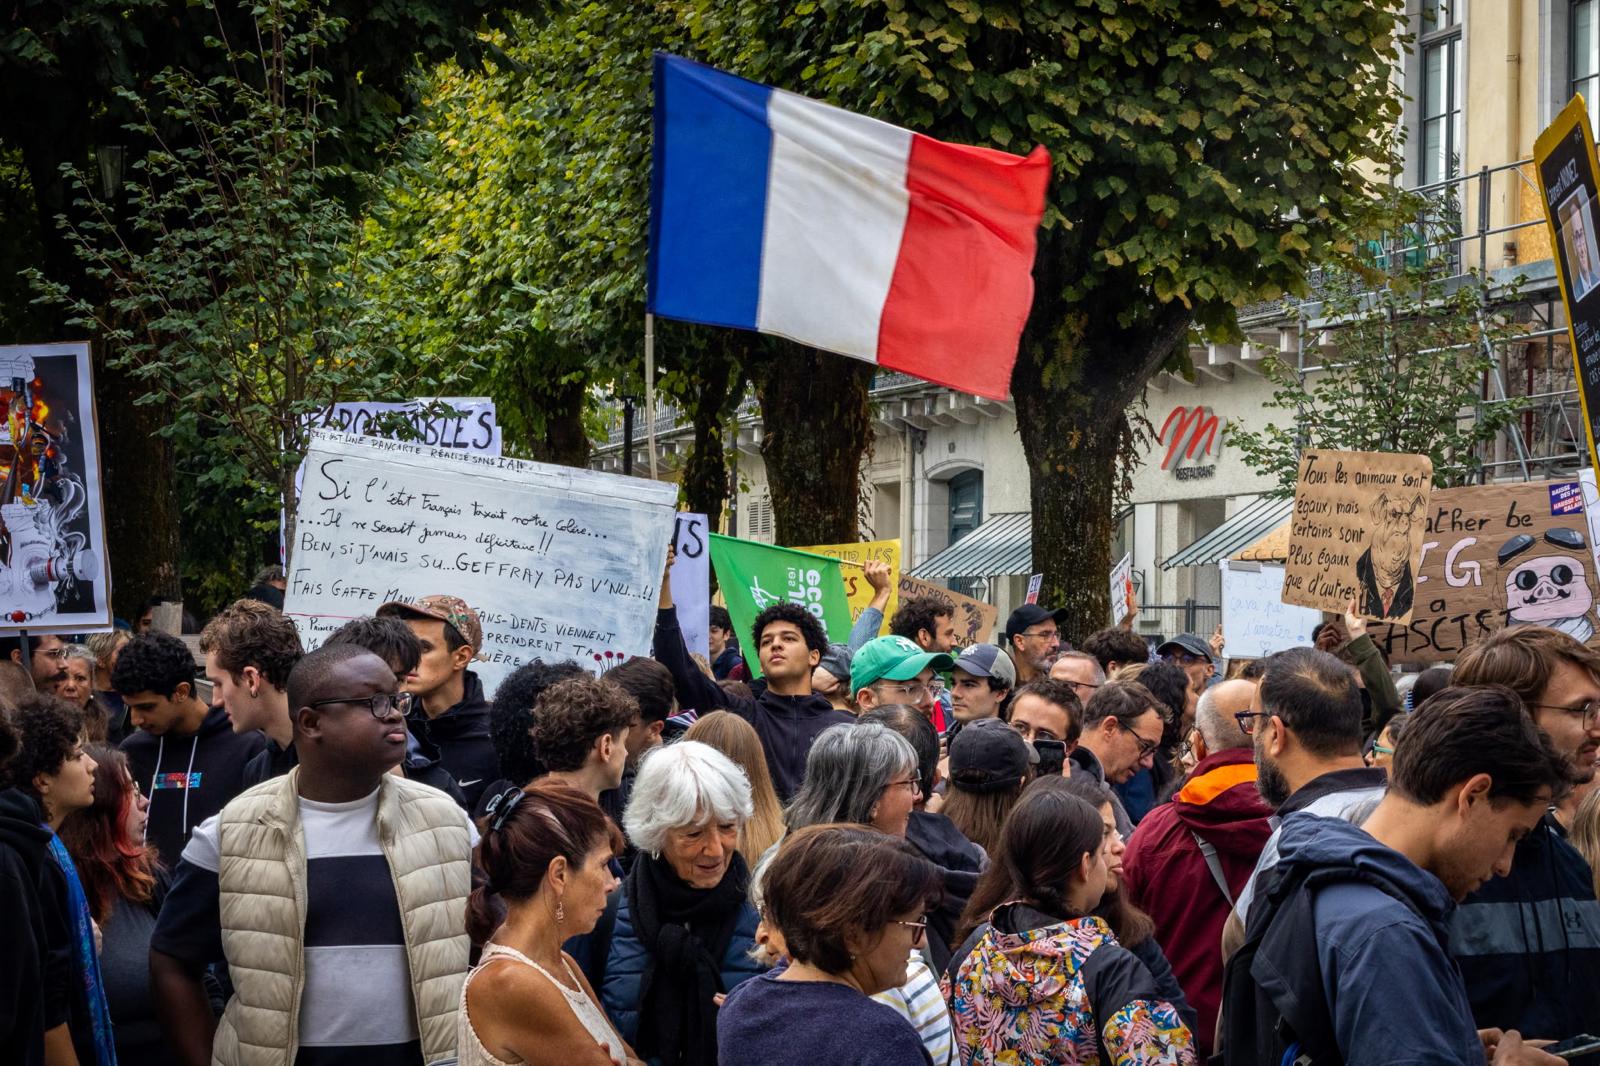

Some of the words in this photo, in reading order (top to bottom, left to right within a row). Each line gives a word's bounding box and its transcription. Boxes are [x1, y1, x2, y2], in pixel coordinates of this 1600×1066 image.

[472, 456, 495, 466] SANS
[1175, 464, 1217, 481] RESTAURANT
[1334, 460, 1348, 485] les
[1355, 471, 1397, 486] animaux
[1402, 471, 1428, 489] sont
[318, 459, 351, 501] Si
[511, 513, 549, 528] notre
[1336, 499, 1359, 515] mais
[1425, 507, 1491, 534] ather
[1505, 500, 1534, 528] be
[351, 520, 367, 530] ne
[418, 523, 468, 544] jamais
[1339, 526, 1365, 544] sont
[355, 544, 408, 565] J'AVAIS
[554, 568, 583, 589] PAS
[1317, 547, 1349, 572] égaux
[1285, 573, 1303, 597] que
[1308, 572, 1356, 601] d'autres
[292, 568, 322, 596] FAIS
[331, 579, 378, 600] GAFFE
[473, 607, 547, 634] ANS-DENTS
[1429, 598, 1446, 613] a
[481, 632, 562, 653] PRENDRENT
